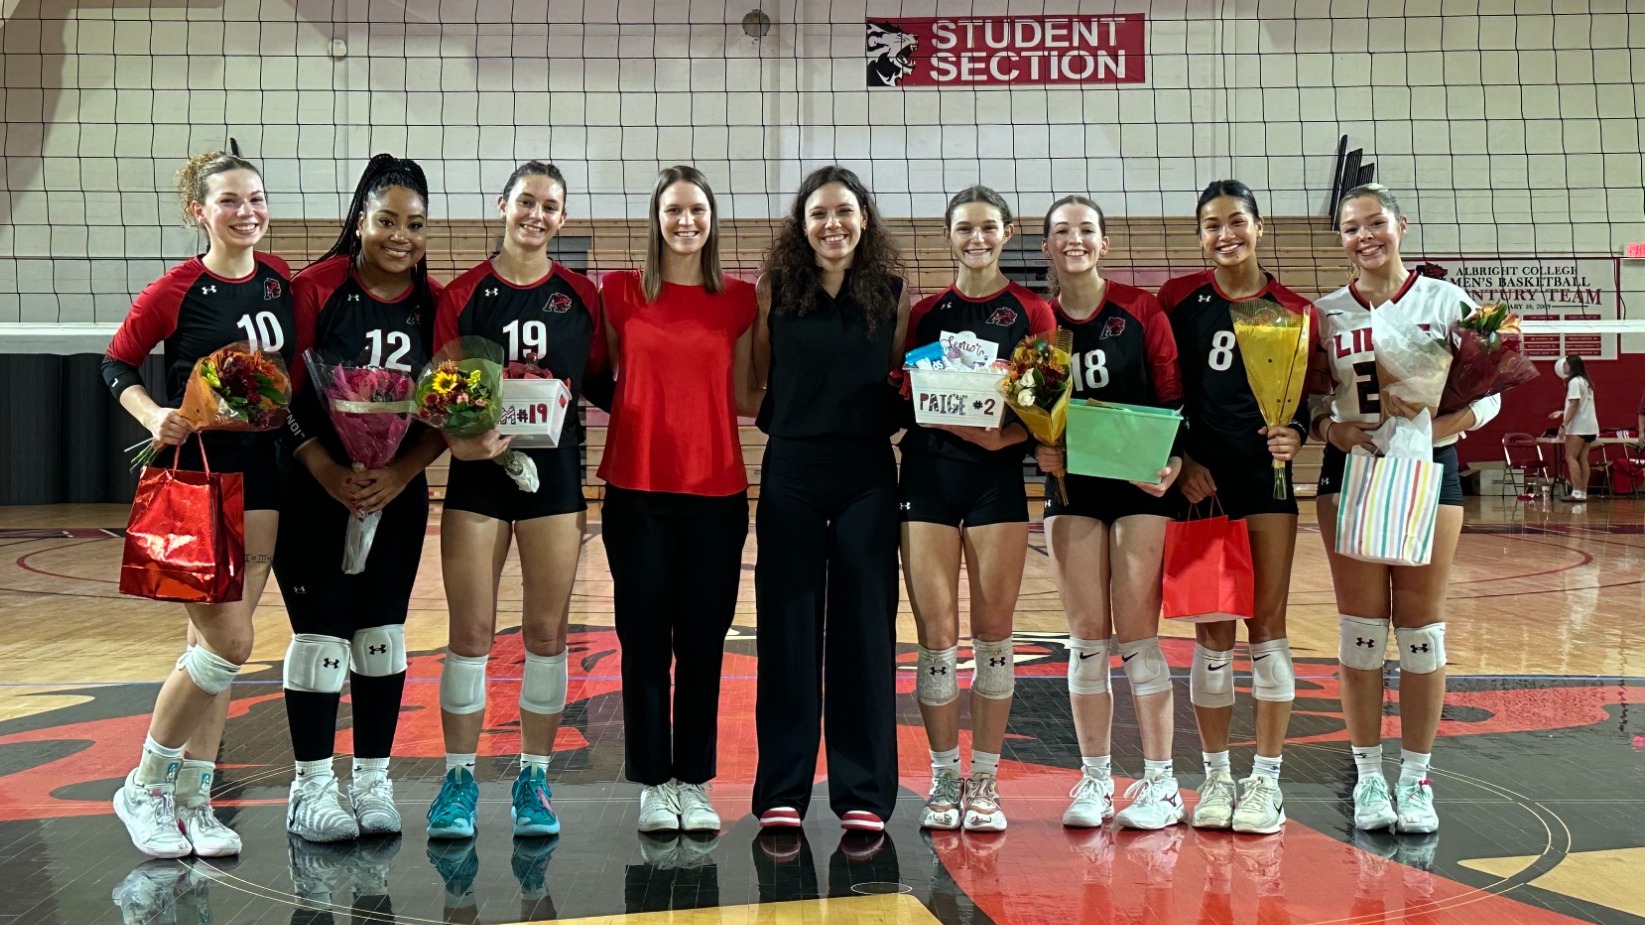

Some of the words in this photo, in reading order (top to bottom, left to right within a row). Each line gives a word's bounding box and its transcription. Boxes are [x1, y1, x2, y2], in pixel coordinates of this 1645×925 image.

[931, 18, 1126, 49] STUDENT
[929, 50, 1126, 81] SECTION
[1456, 266, 1518, 276] ALBRIGHT
[1522, 266, 1577, 276] COLLEGE
[1498, 277, 1590, 288] BASKETBALL
[1470, 289, 1537, 301] NTURY
[1546, 288, 1602, 306] TEAM
[236, 311, 284, 356] 10
[503, 319, 547, 361] 19
[364, 329, 412, 372] 12
[1208, 330, 1236, 371] 8
[1071, 349, 1109, 392] 18
[919, 392, 968, 415] PAIGE
